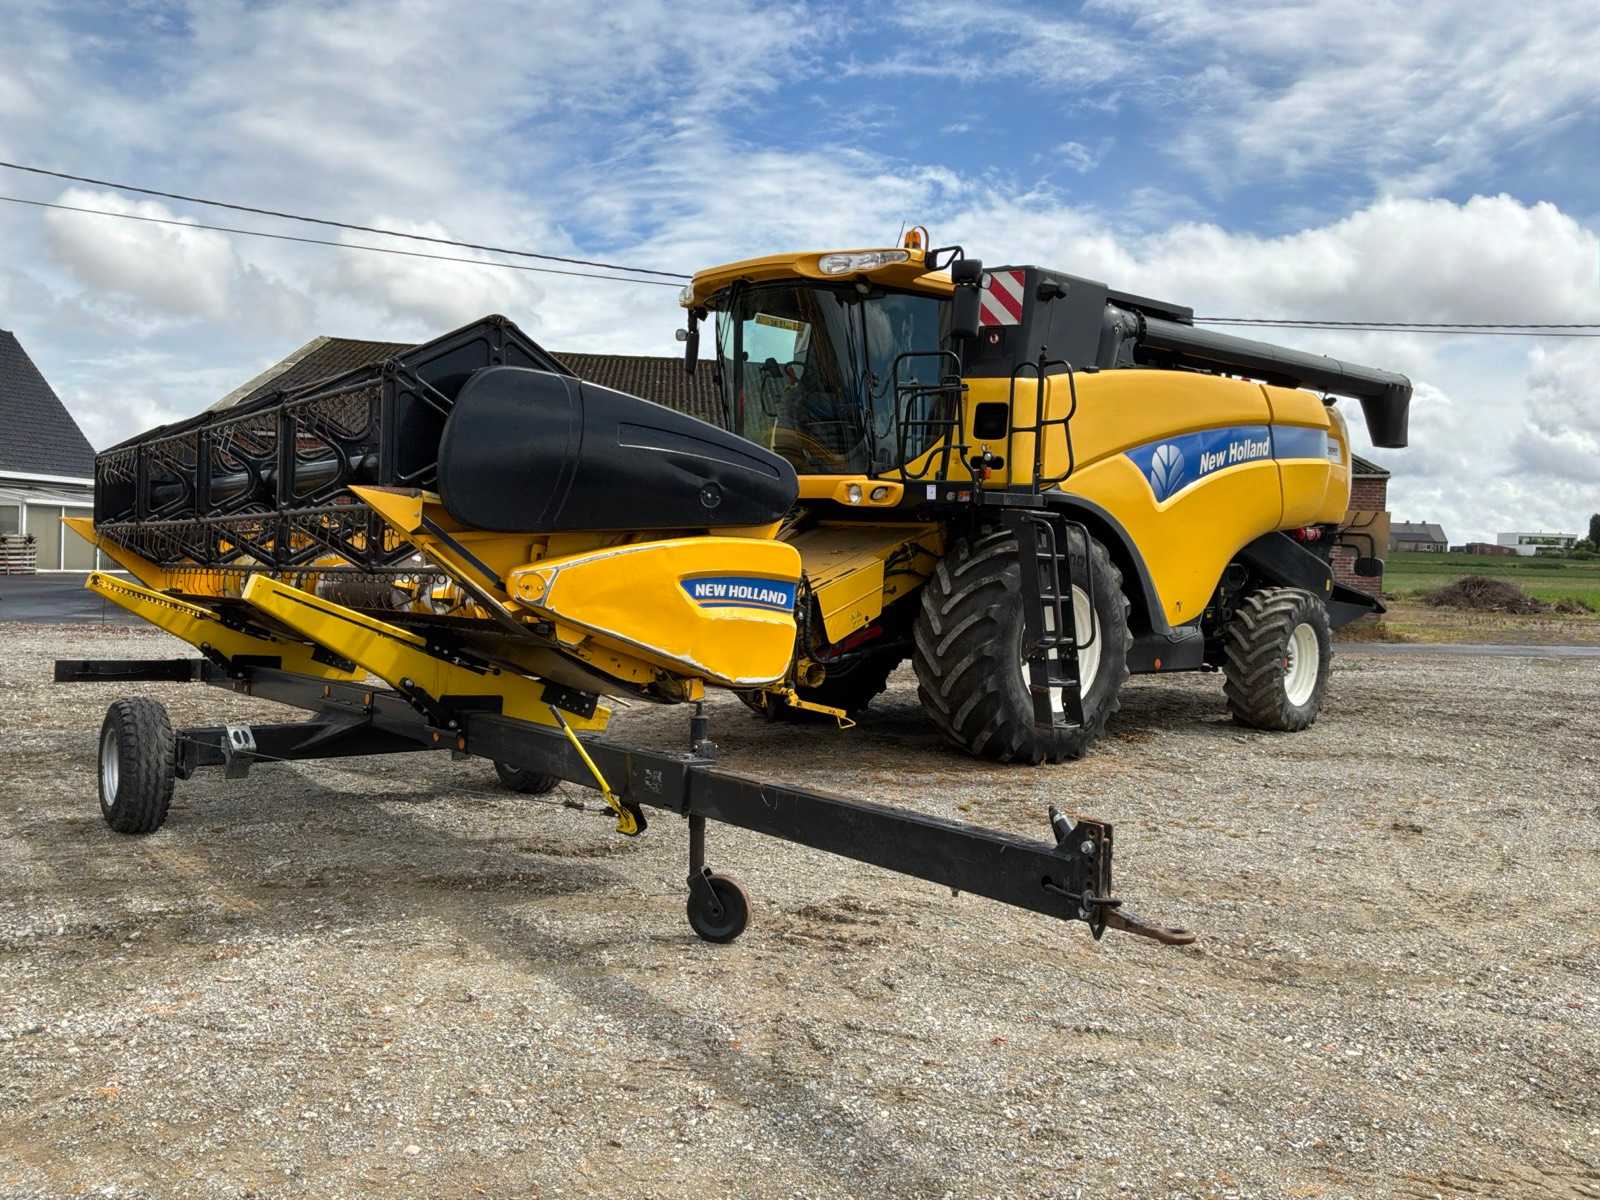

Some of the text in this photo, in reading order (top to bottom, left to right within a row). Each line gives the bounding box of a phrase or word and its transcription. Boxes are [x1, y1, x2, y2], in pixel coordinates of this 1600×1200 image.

[1199, 437, 1270, 475] New Holland
[695, 584, 787, 605] NEW HOLLAND
